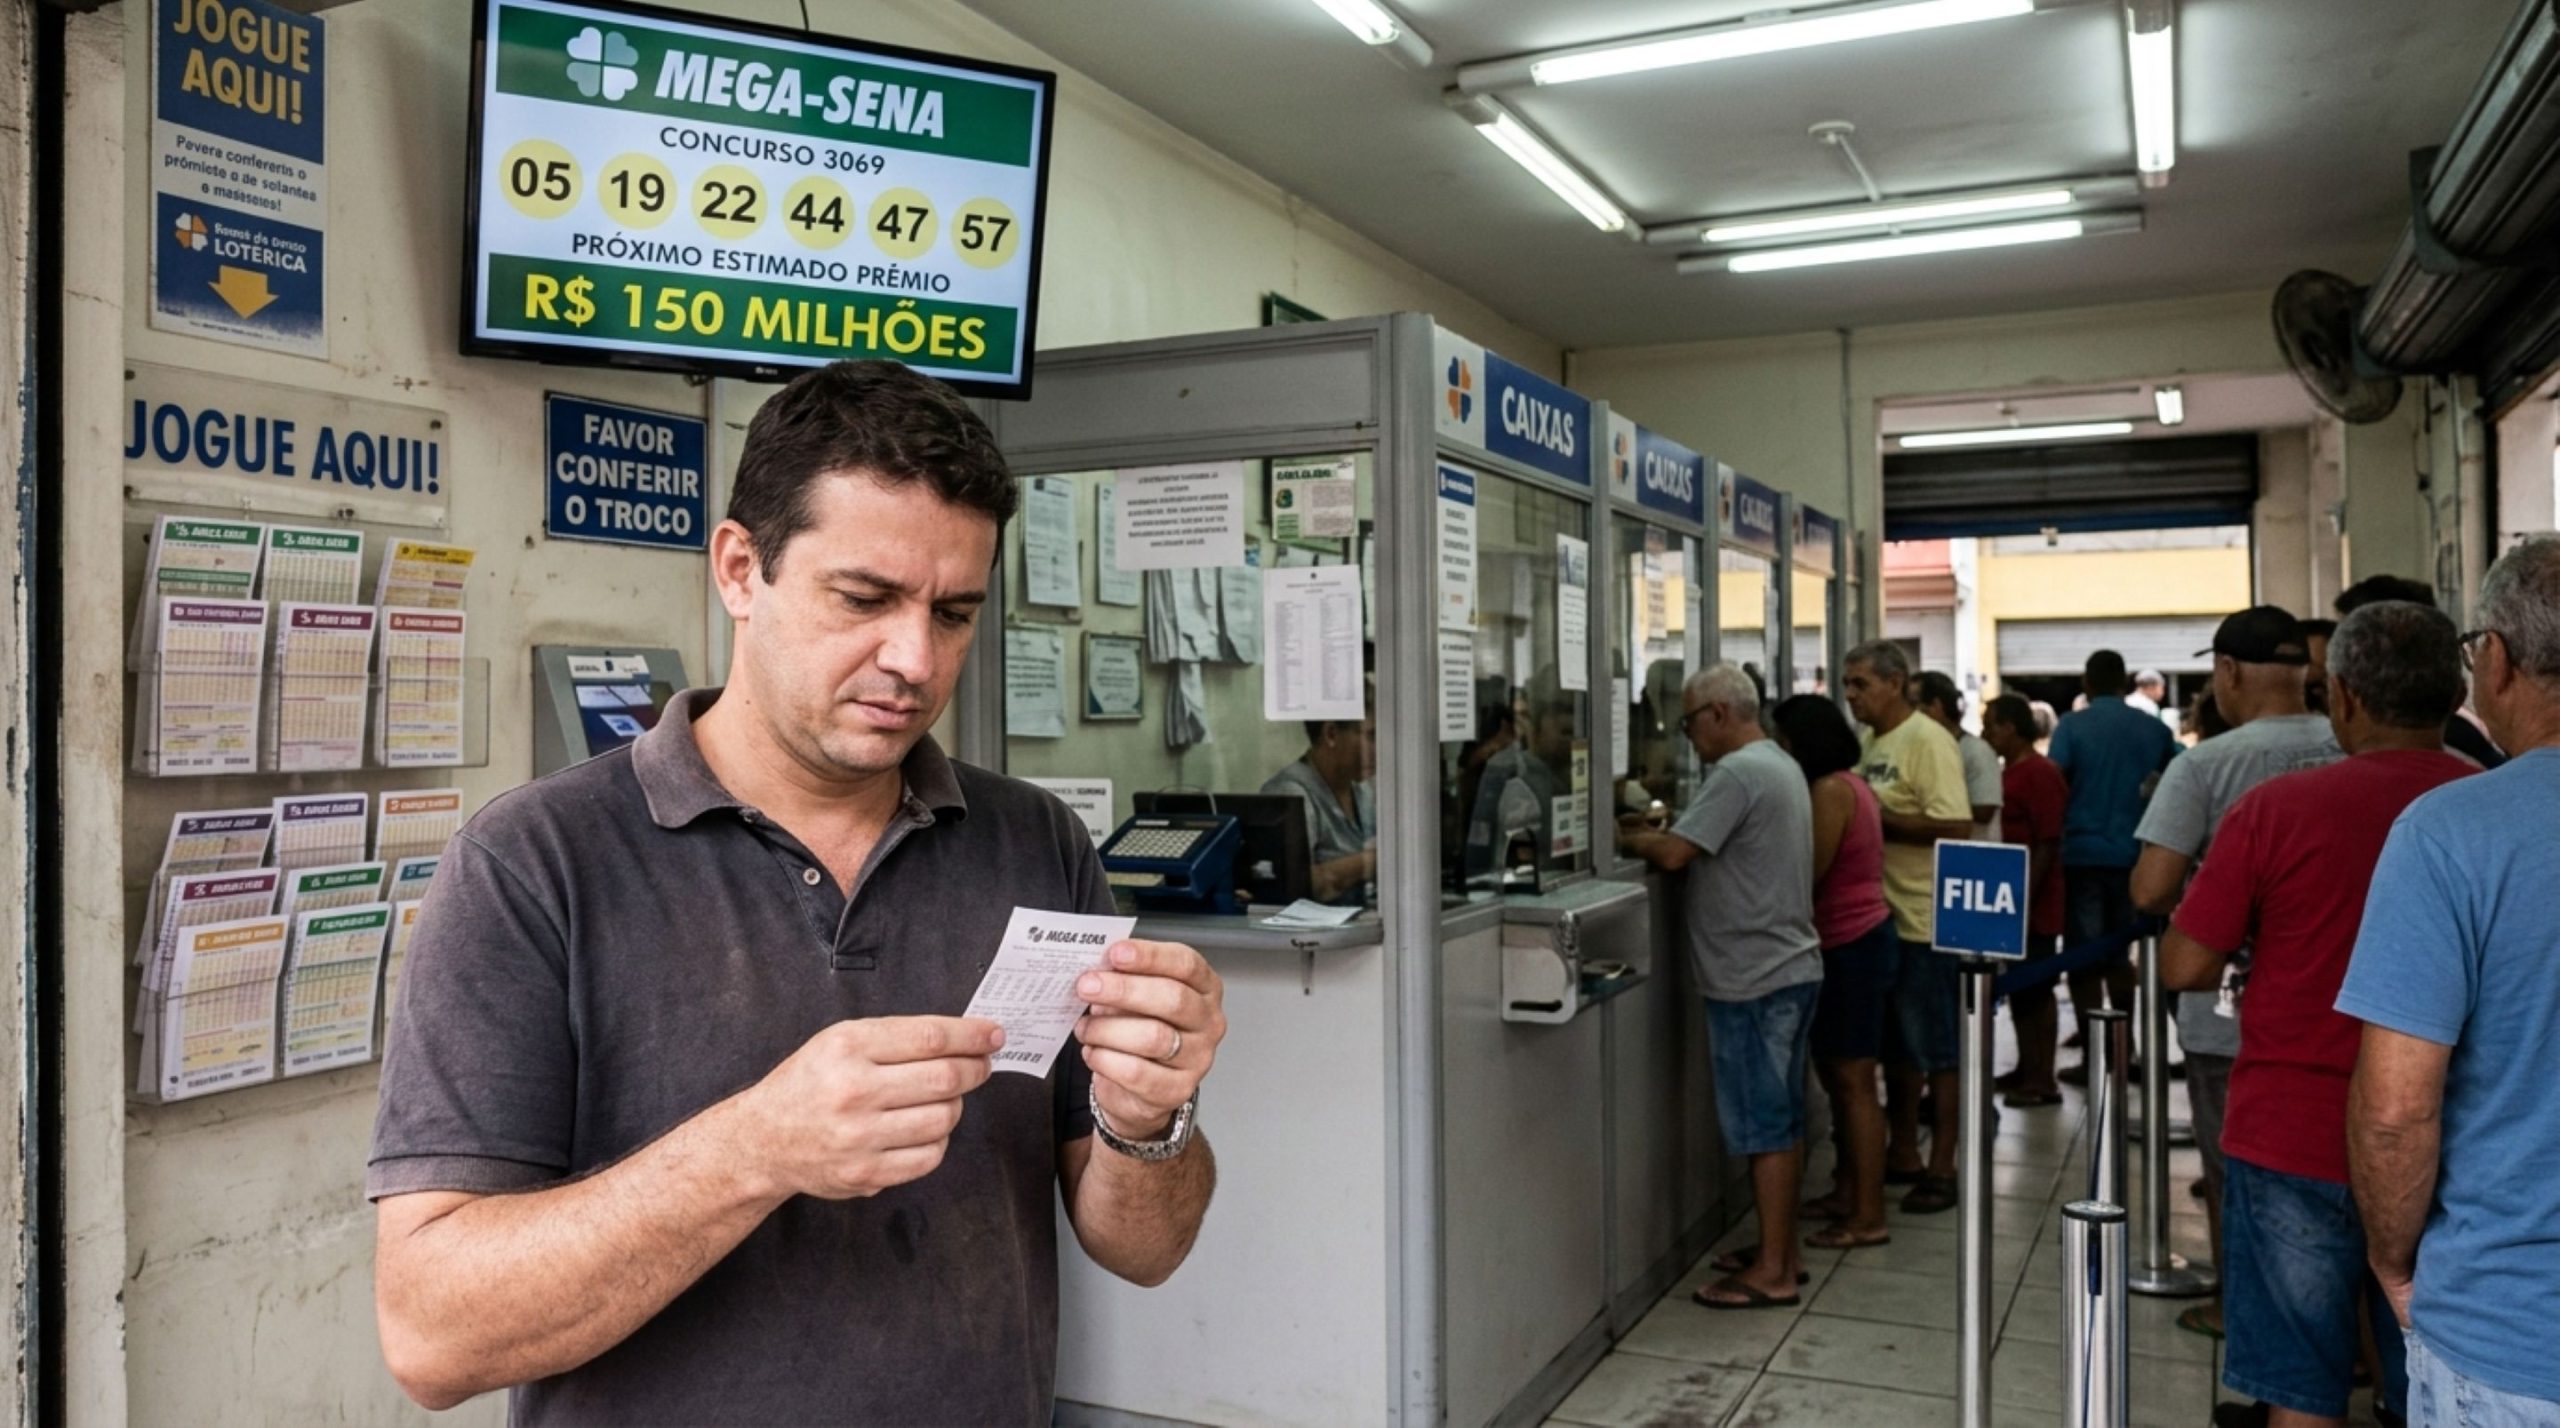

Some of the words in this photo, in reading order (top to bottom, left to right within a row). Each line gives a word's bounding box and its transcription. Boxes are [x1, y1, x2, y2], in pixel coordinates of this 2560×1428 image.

[173, 0, 310, 73] JOGUE
[181, 48, 303, 125] AQUI!
[655, 49, 945, 139] MEGA-SENA
[659, 127, 815, 166] CONCURSO
[823, 149, 885, 175] 3069
[510, 157, 572, 201] 05
[609, 171, 665, 212] 19
[701, 181, 757, 223] 22
[790, 193, 845, 234] 44
[876, 204, 929, 243] 47
[960, 214, 1010, 252] 57
[214, 238, 308, 274] LOTERICA
[571, 231, 702, 267] PRÓXIMO
[712, 249, 847, 283] ESTIMADO
[525, 273, 596, 329] R$
[623, 283, 725, 336] 150
[742, 299, 987, 360] MILHÕES
[584, 413, 676, 456] FAVOR
[1502, 385, 1575, 458] CAIXAS
[124, 399, 296, 478] JOGUE
[311, 426, 440, 495] AQUI!
[556, 451, 700, 498] CONFERIR
[564, 494, 587, 525] O
[594, 497, 692, 536] TROCO
[1943, 877, 2016, 915] FILA
